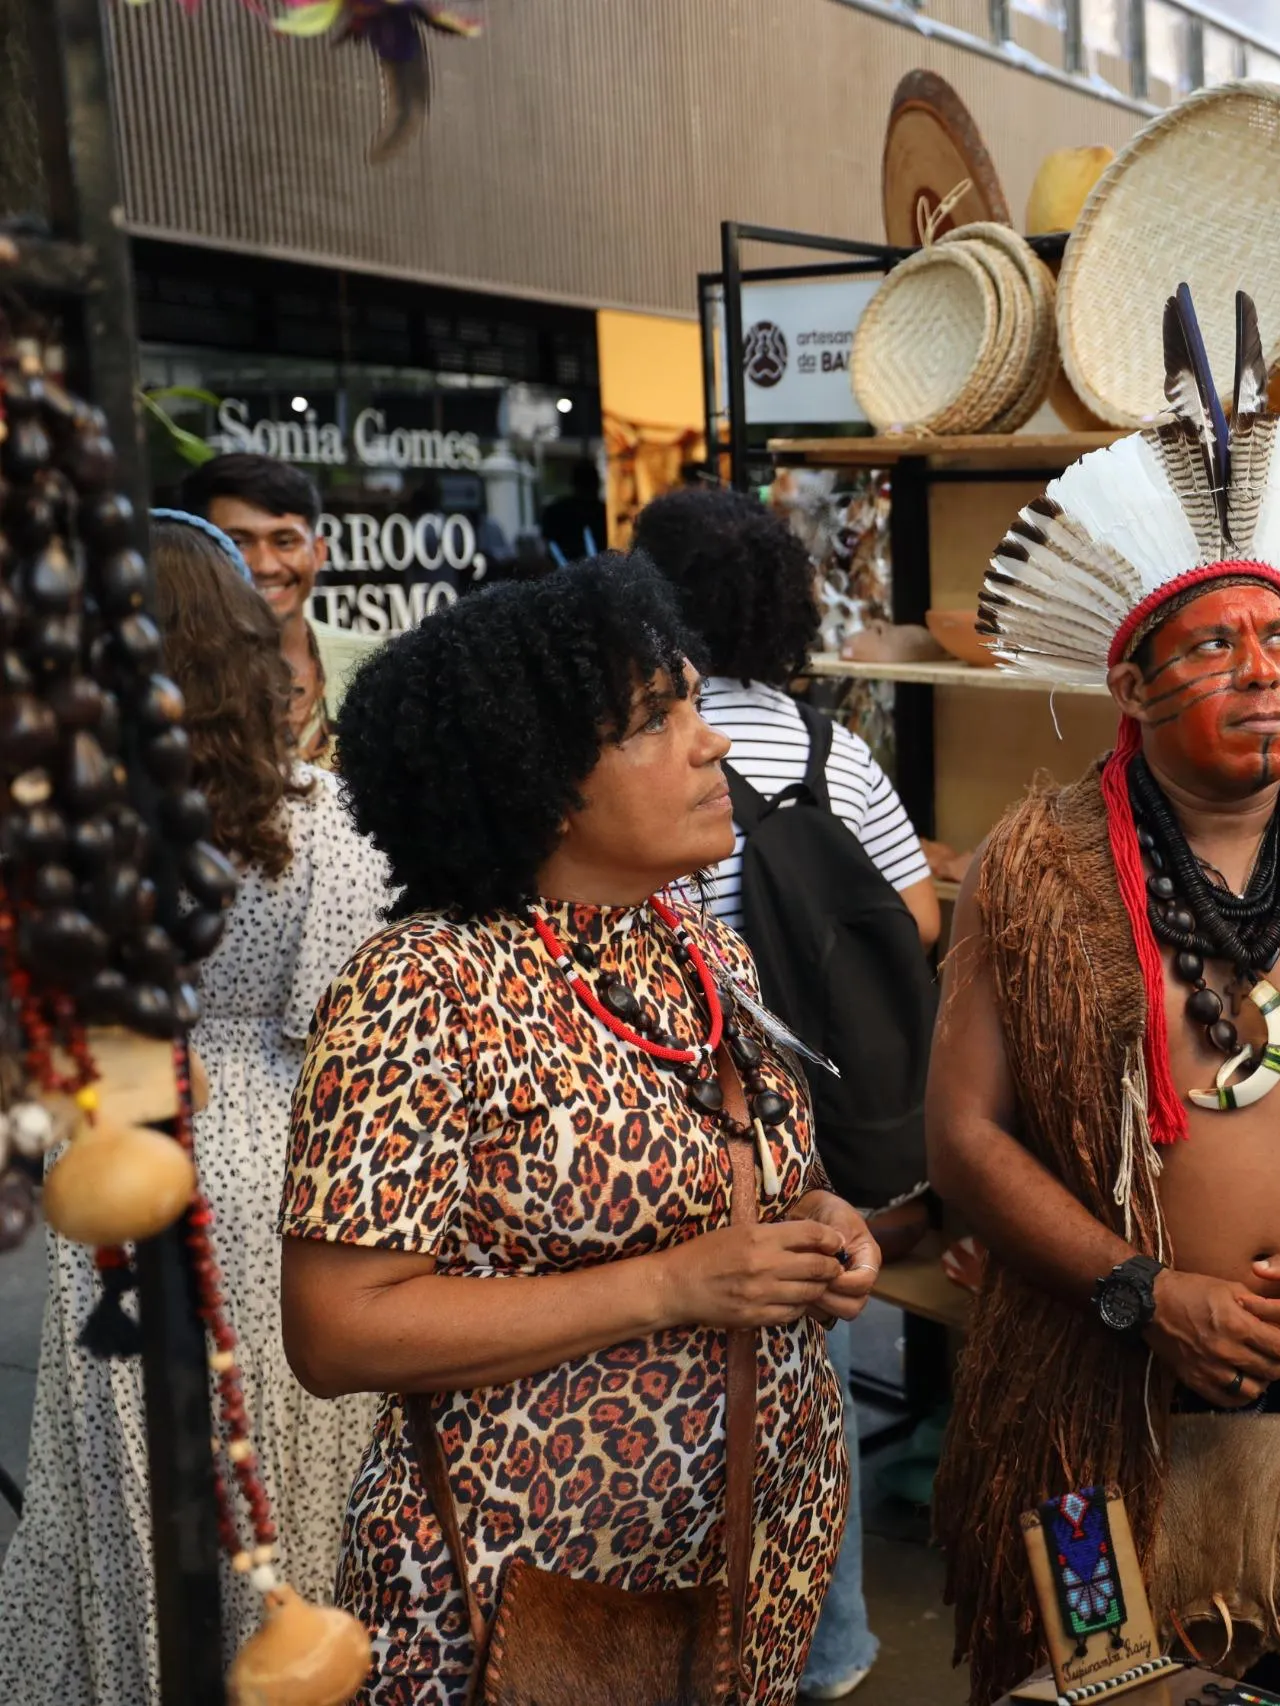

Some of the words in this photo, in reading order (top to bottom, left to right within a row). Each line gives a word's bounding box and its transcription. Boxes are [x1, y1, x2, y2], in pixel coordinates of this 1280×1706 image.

[797, 351, 816, 368] da
[218, 397, 347, 464] Sonia
[354, 407, 482, 471] Gomes
